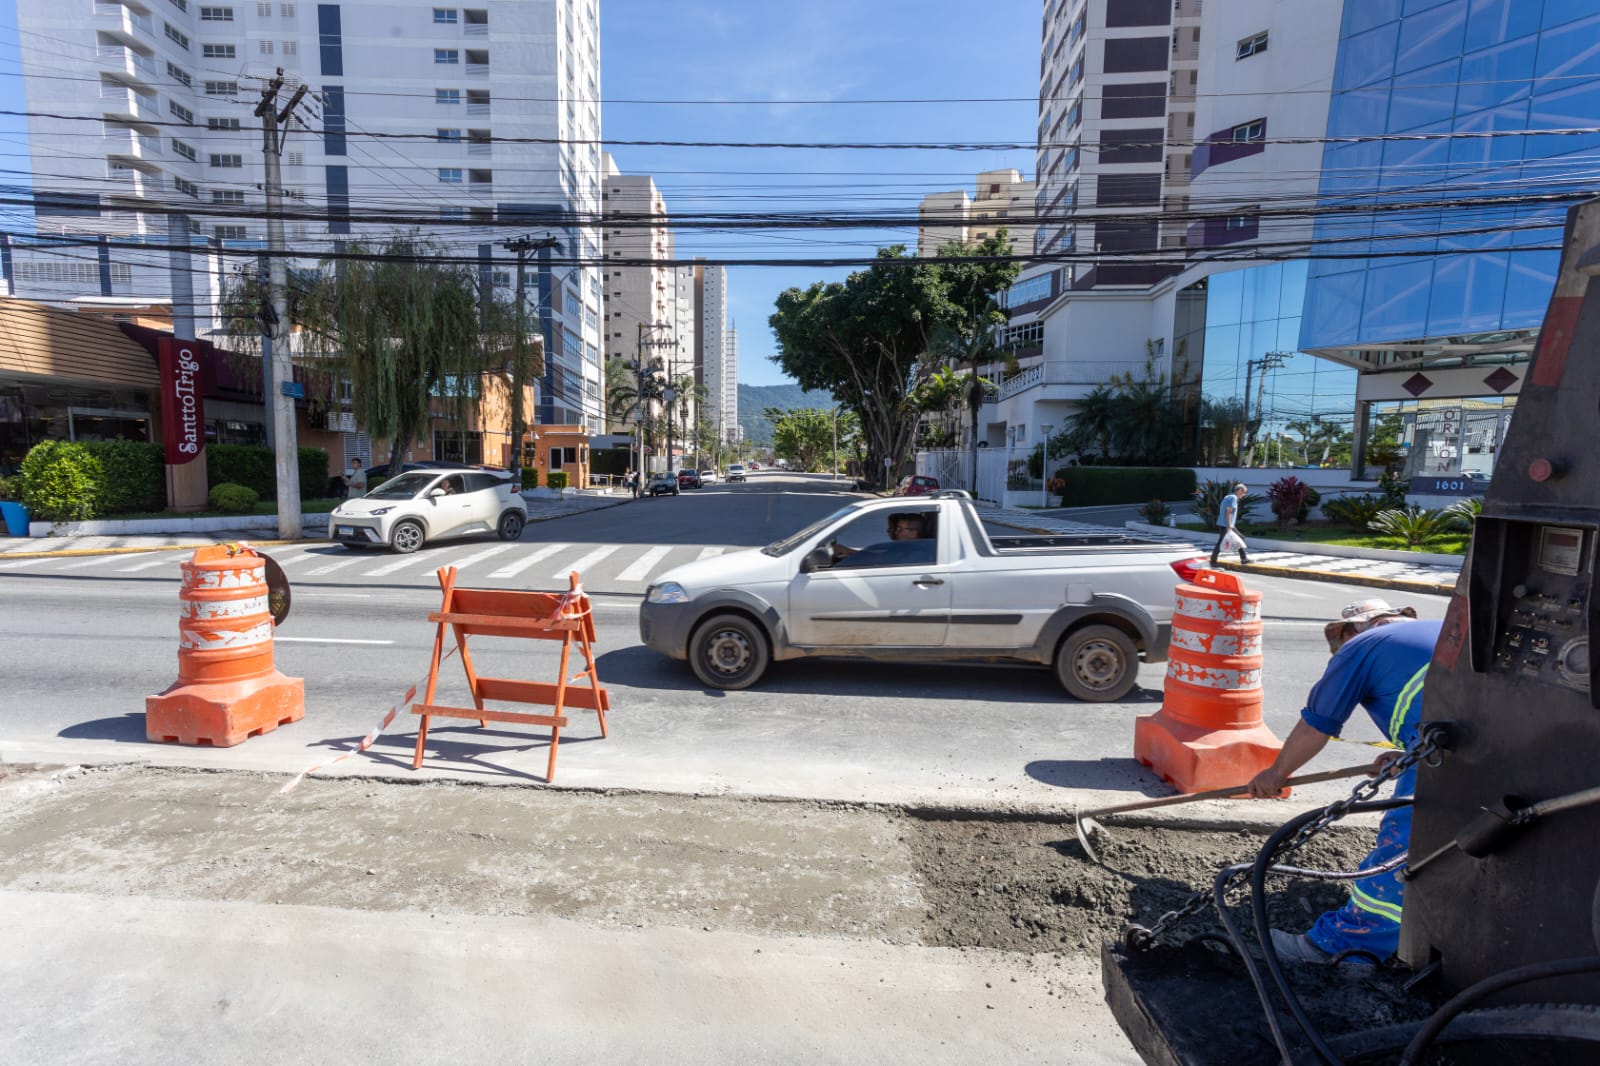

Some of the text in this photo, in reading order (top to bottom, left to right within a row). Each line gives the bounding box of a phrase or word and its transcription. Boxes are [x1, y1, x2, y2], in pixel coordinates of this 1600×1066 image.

[174, 348, 200, 454] SanttoTrigo
[1437, 410, 1456, 472] ORION
[1436, 481, 1465, 490] 1601
